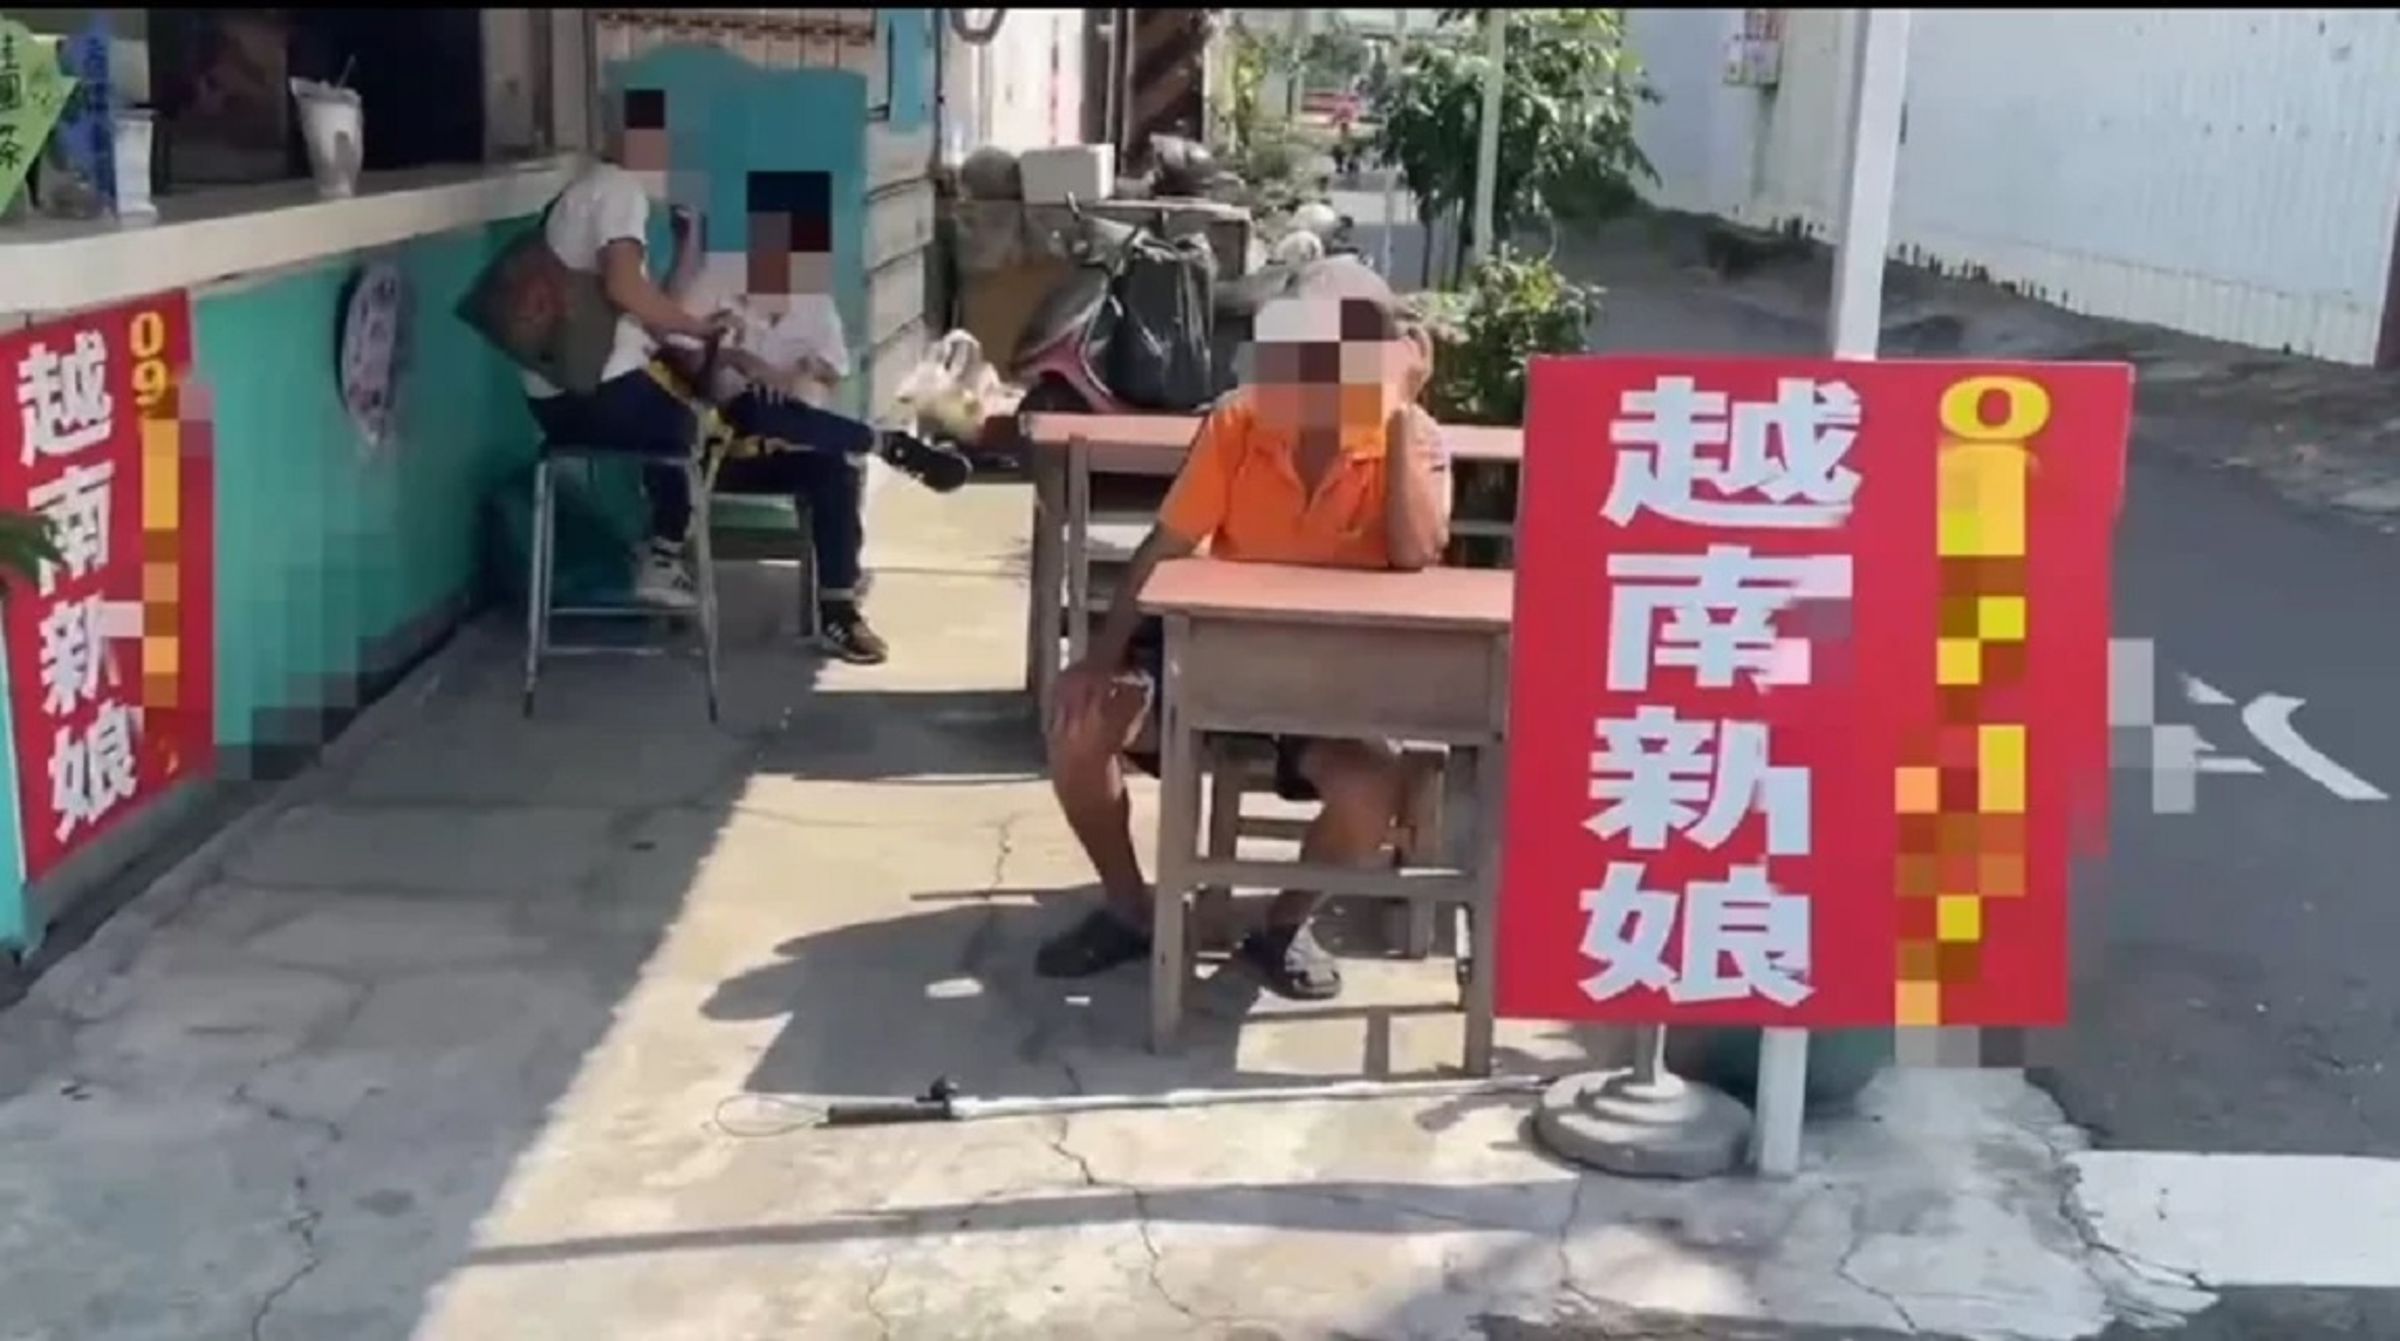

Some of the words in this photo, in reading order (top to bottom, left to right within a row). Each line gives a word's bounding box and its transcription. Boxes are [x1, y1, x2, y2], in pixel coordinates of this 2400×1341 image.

[17, 329, 142, 842] 越南新娘
[1579, 375, 1862, 1007] 越南新娘
